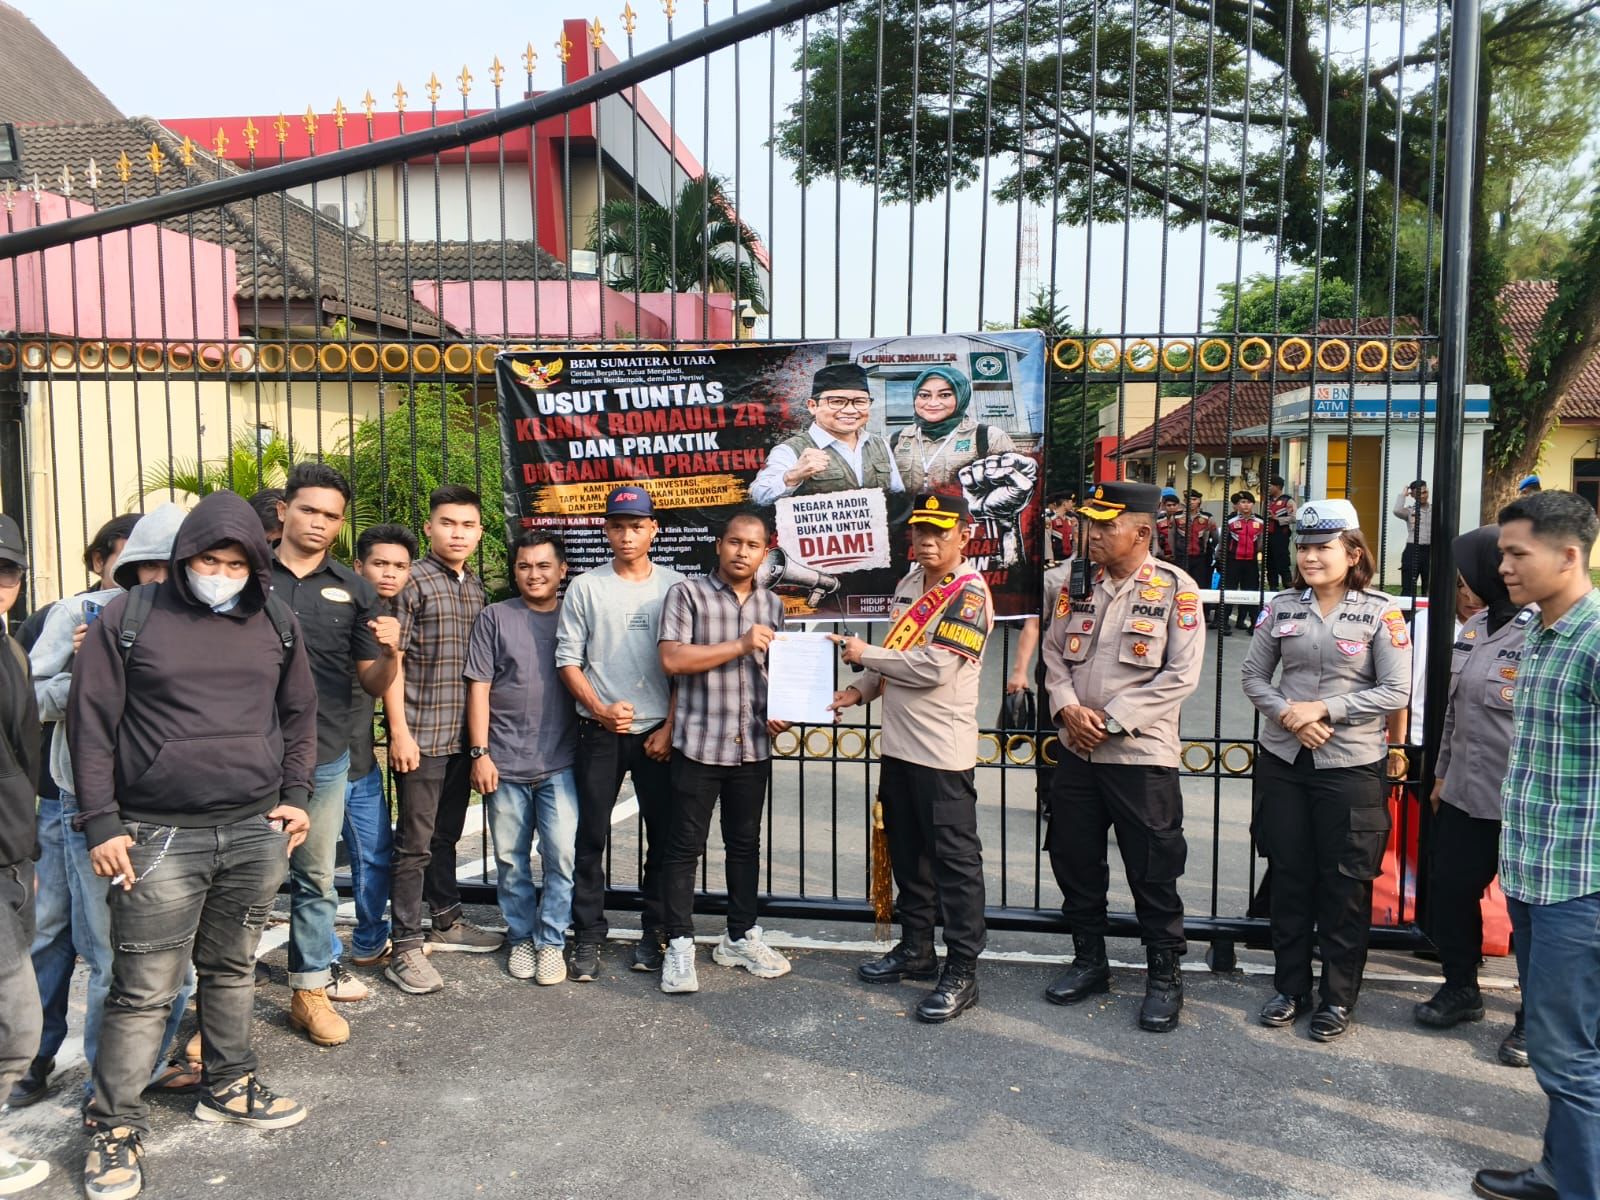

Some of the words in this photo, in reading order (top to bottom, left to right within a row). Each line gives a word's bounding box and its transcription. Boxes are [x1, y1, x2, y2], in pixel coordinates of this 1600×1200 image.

[570, 359, 597, 369] BEM
[600, 356, 670, 369] SUMATERA
[673, 355, 716, 366] UTARA
[571, 377, 602, 386] Bergerak
[680, 374, 705, 382] Pertiwi
[536, 389, 607, 415] USUT
[614, 381, 724, 410] TUNTAS
[1332, 387, 1350, 400] BN
[1317, 401, 1344, 411] ATM
[515, 414, 604, 442] KLINIK
[608, 405, 726, 436] ROMAULI
[732, 402, 766, 427] ZR
[569, 438, 616, 459] DAN
[622, 431, 720, 456] PRAKTIK
[522, 458, 609, 484] DUGAAN
[613, 455, 660, 480] MAL
[663, 448, 766, 476] PRAKTEK!
[559, 495, 577, 503] TAPI
[581, 494, 602, 502] KAMI
[676, 485, 728, 497] LINGKUNGAN
[583, 485, 604, 493] KAMI
[568, 504, 585, 512] DAN
[659, 498, 687, 507] SUARA
[689, 495, 722, 505] RAKYAT!
[792, 500, 834, 513] NEGARA
[836, 497, 868, 509] HADIR
[567, 517, 589, 525] KAMI
[794, 512, 828, 524] UNTUK
[796, 524, 833, 536] BUKAN
[836, 520, 872, 533] UNTUK
[798, 532, 875, 558] DIAM!
[860, 597, 886, 605] HIDUP
[860, 605, 886, 613] HIDUP
[1131, 604, 1166, 617] POLRI
[1339, 612, 1375, 625] POLRI
[1497, 648, 1522, 661] POL
